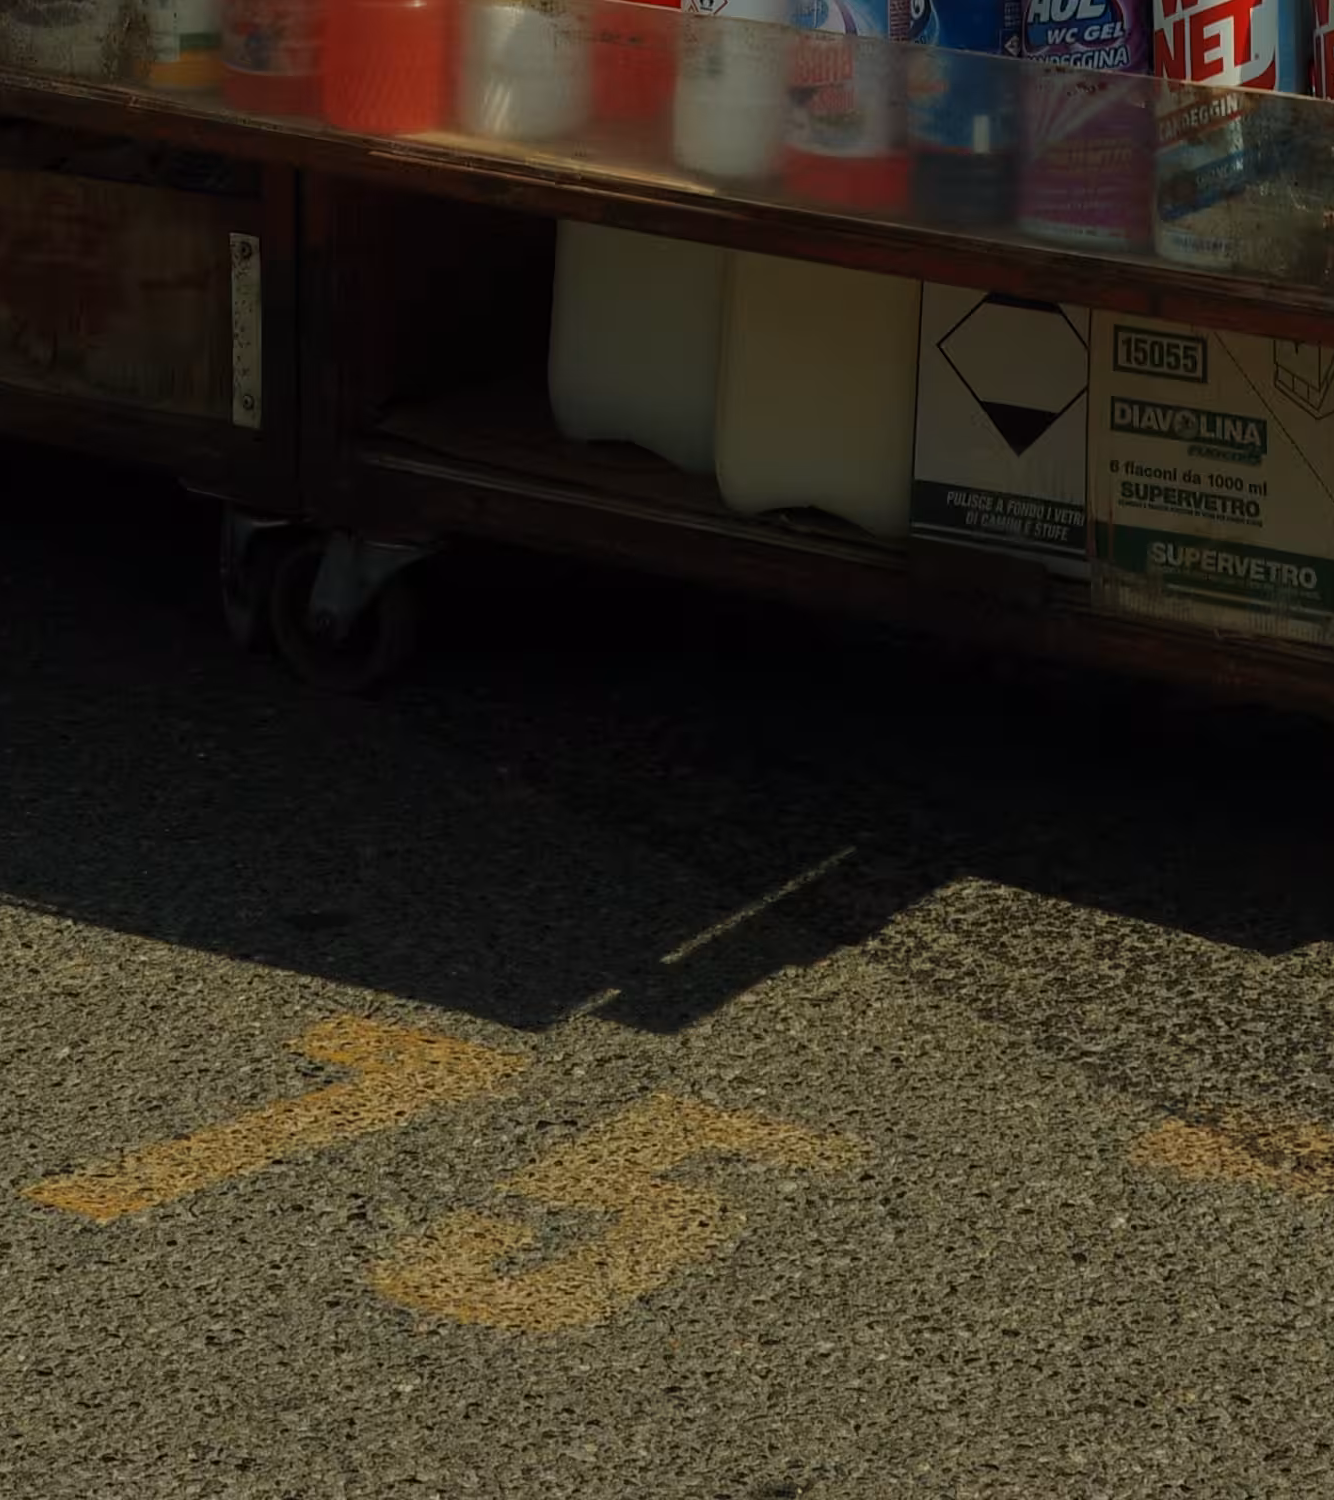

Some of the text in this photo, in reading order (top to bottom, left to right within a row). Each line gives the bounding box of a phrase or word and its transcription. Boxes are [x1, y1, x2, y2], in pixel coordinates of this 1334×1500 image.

[1045, 19, 1125, 46] WC GEL
[1118, 333, 1199, 374] 15055
[1113, 403, 1262, 446] DIAVOLINA
[1123, 463, 1175, 483] flaconi
[1180, 471, 1203, 485] da
[1207, 473, 1244, 494] 1000
[1247, 479, 1268, 497] ml
[946, 490, 993, 513] PULISCE
[994, 498, 1005, 513] A
[1005, 500, 1045, 520] FONDO
[1053, 506, 1086, 527] VETRI
[1120, 482, 1260, 518] SUPERVETRO
[964, 510, 977, 525] DI
[1033, 521, 1069, 542] STUFE
[1151, 541, 1318, 590] SUPERVETRO
